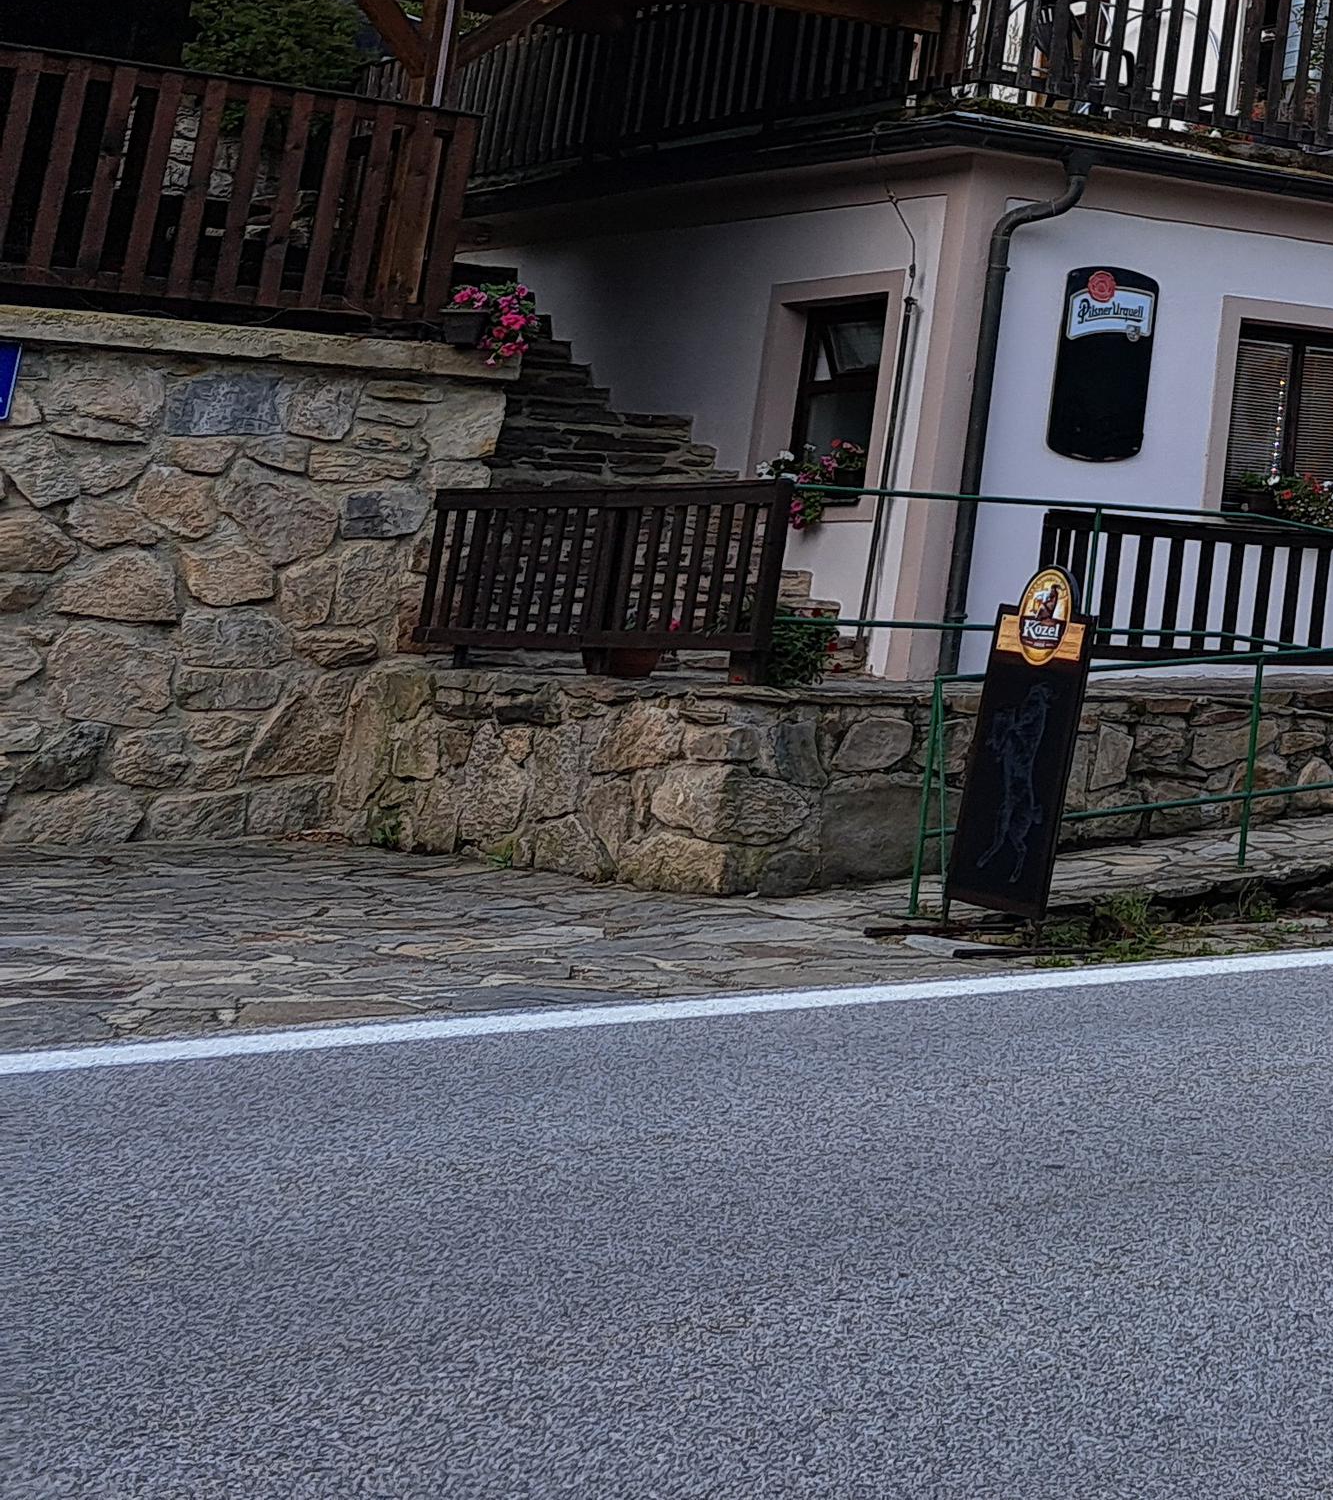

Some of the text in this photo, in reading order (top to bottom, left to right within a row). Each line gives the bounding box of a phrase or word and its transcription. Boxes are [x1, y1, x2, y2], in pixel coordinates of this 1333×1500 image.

[1078, 298, 1144, 324] Pilsner Urquell
[1022, 619, 1060, 641] Kozel
